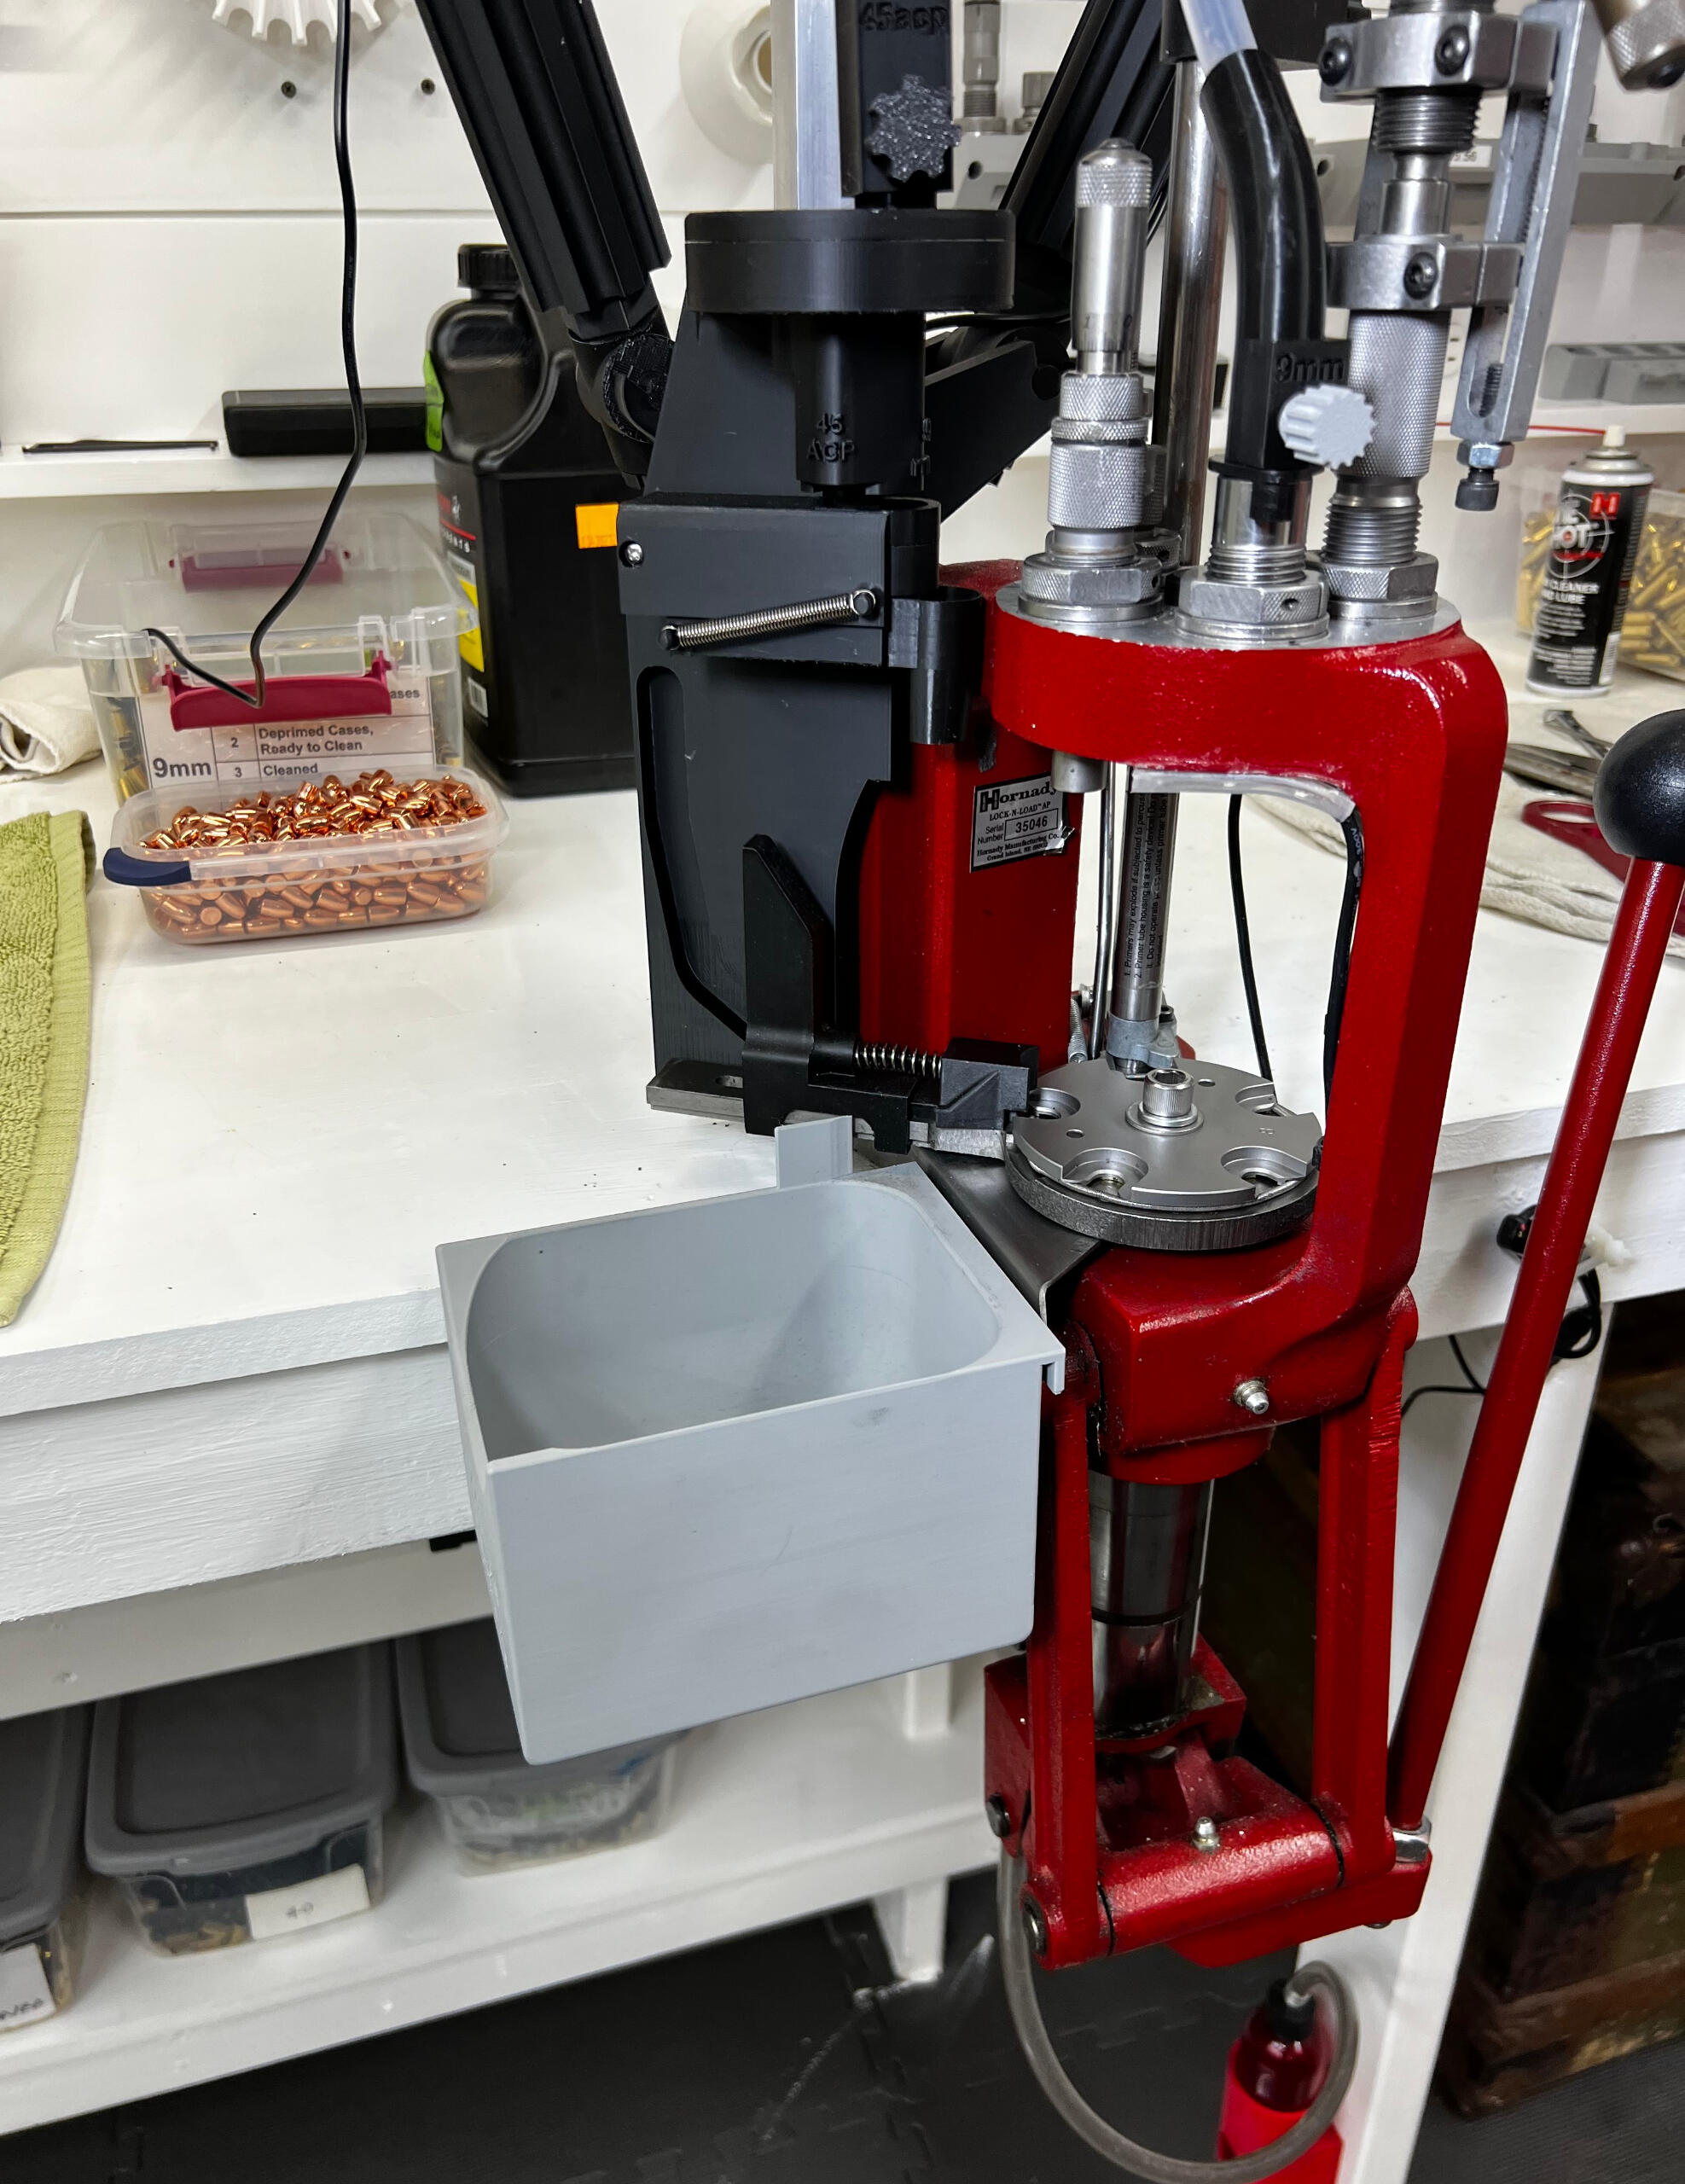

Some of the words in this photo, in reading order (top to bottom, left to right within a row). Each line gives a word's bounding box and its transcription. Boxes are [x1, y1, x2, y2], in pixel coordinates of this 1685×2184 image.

[1275, 352, 1345, 384] 9mm
[816, 412, 844, 435] 45
[389, 688, 421, 700] ases
[259, 726, 324, 741] Deprimed
[328, 723, 375, 738] Cases,
[230, 737, 239, 749] 2
[260, 741, 303, 758] Ready
[305, 741, 321, 753] to
[324, 740, 363, 752] Clean
[152, 757, 212, 778] 9mm
[234, 767, 242, 778] 3
[263, 763, 318, 776] Cleaned
[985, 822, 1004, 834] Serial
[1015, 815, 1048, 834] 35046
[977, 833, 1004, 845] Number
